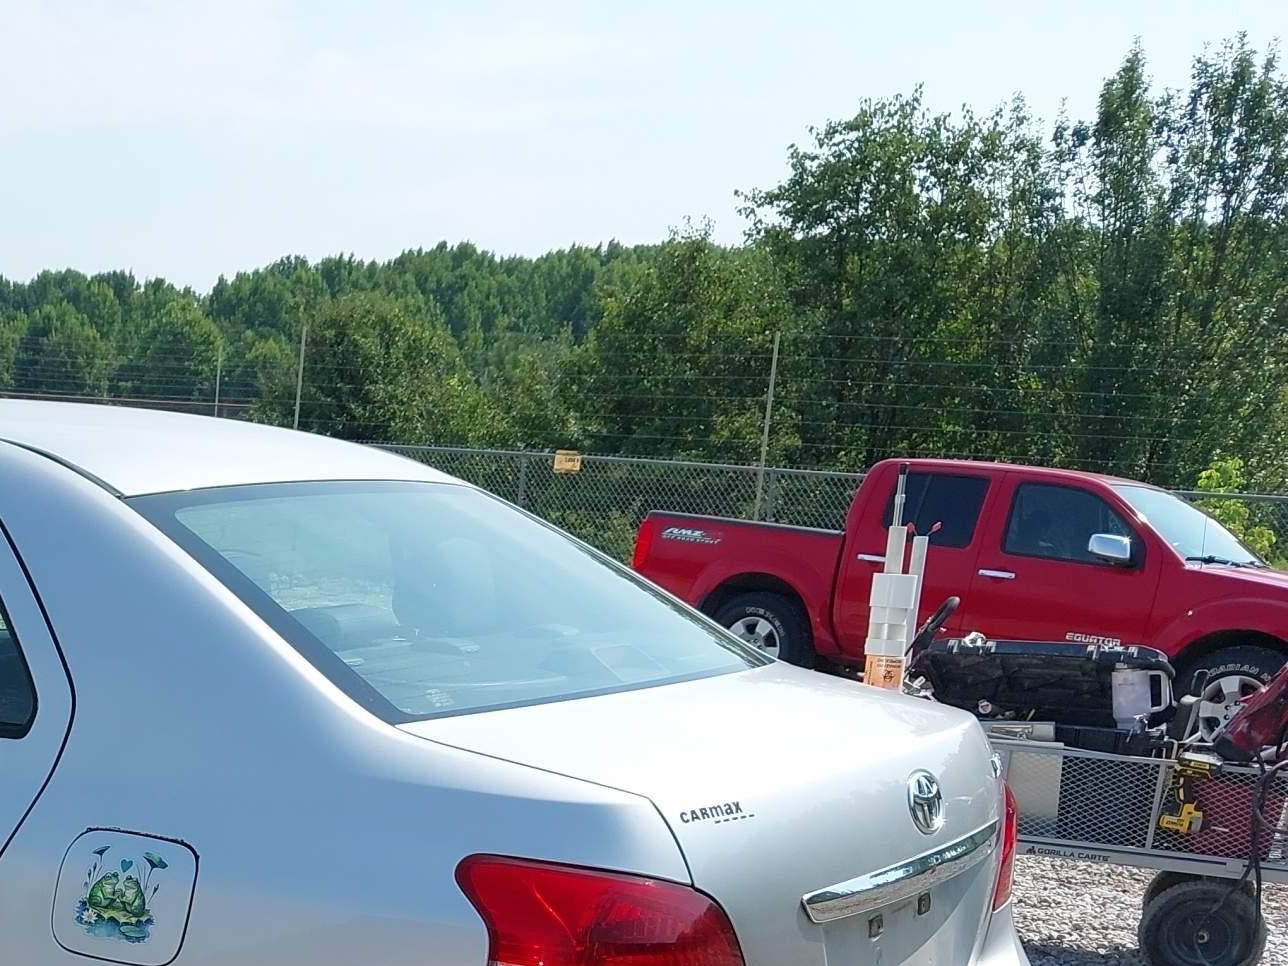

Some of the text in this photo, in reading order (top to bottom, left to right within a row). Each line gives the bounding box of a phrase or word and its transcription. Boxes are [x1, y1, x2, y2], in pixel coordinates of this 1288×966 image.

[1065, 632, 1121, 647] EQUATOR
[1037, 848, 1110, 862] GORILLA CARTS
